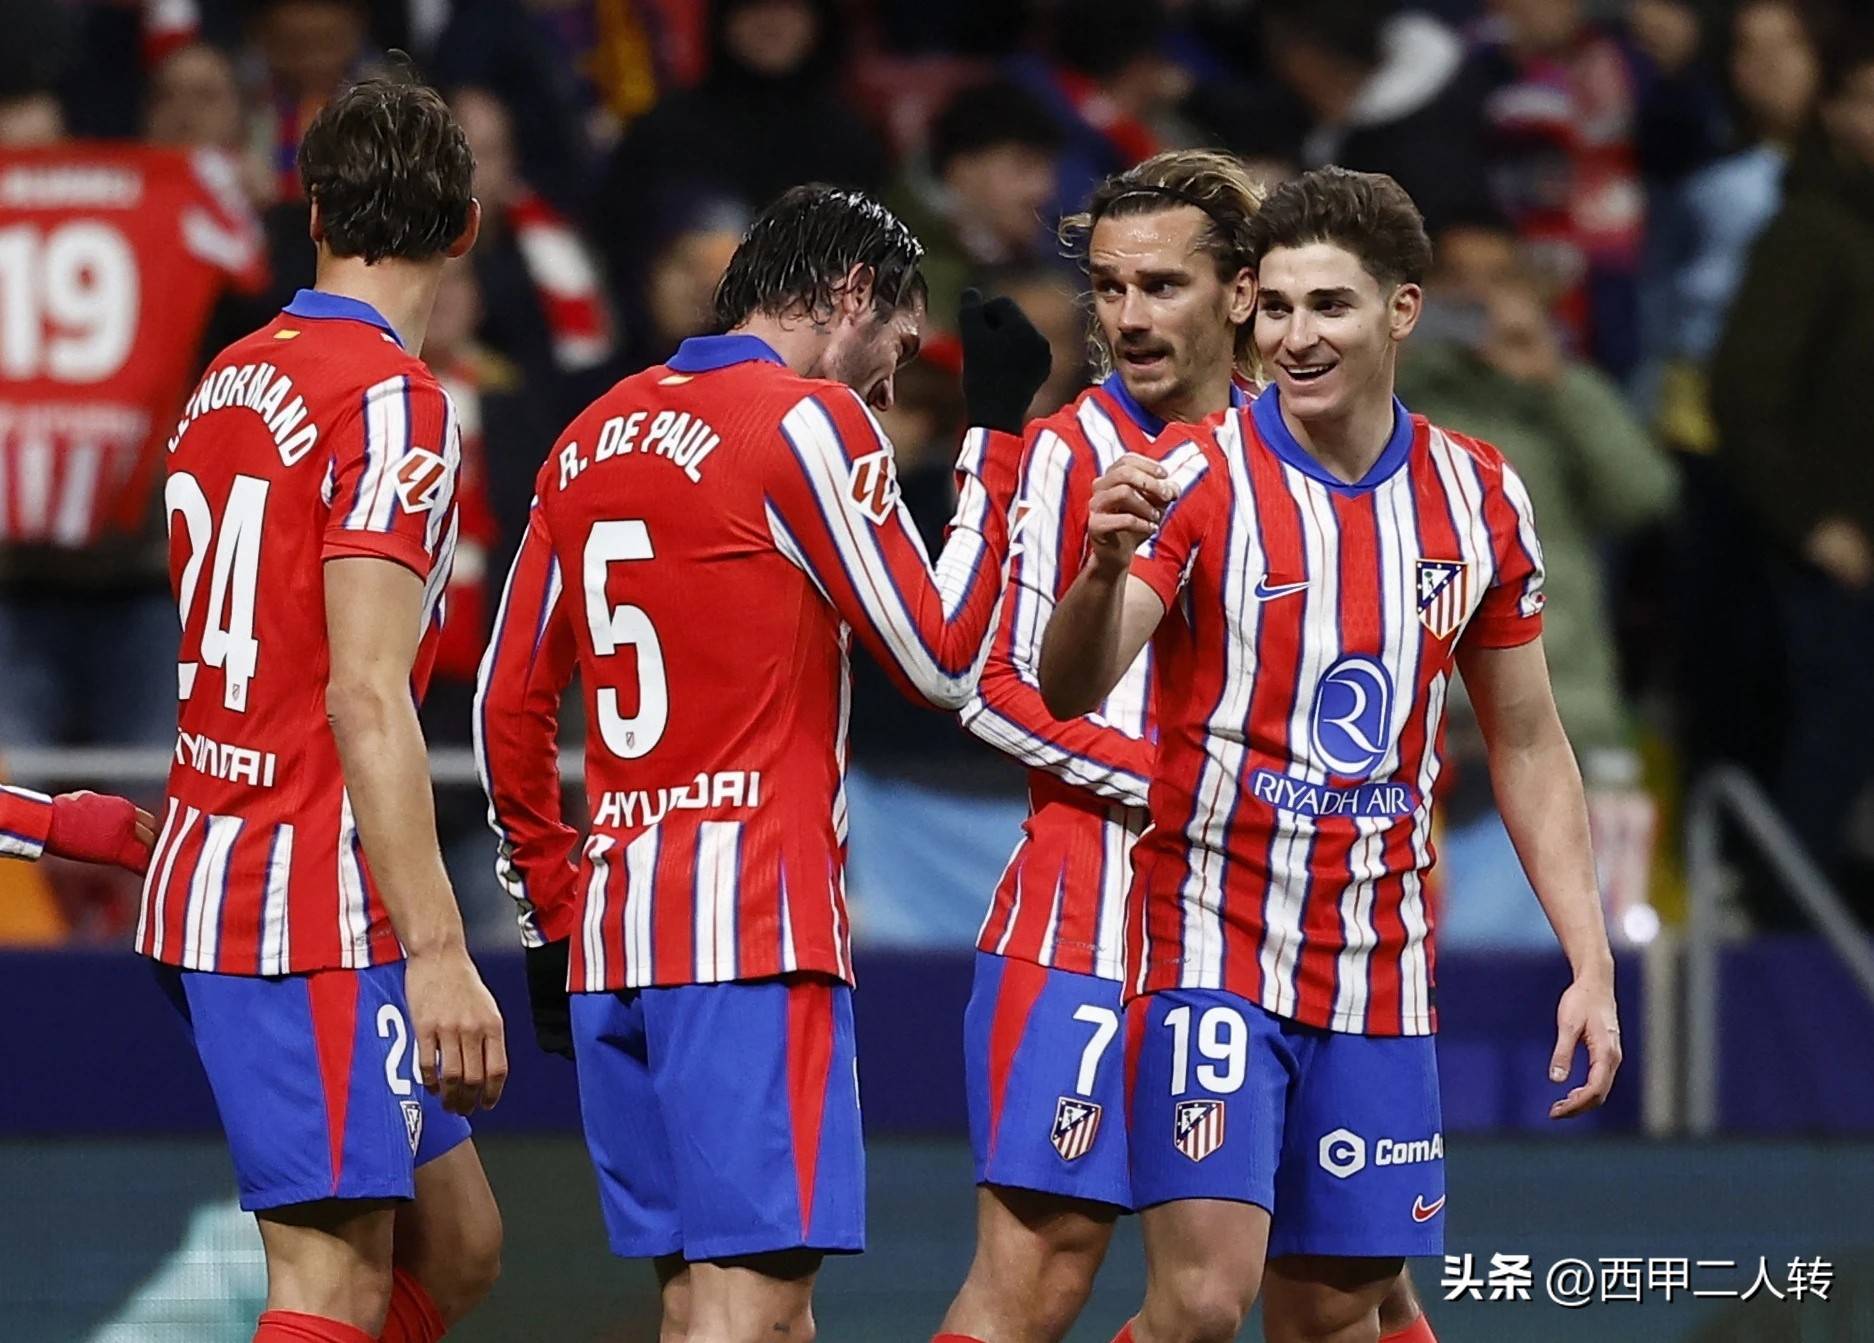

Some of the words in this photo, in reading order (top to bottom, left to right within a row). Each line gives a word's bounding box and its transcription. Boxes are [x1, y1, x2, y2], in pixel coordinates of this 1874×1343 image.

[0, 222, 141, 381] 19
[559, 441, 588, 491] R.
[595, 411, 647, 463] DE
[642, 411, 720, 483] PAUL
[164, 471, 270, 713] 24
[583, 519, 669, 759] 5
[1255, 773, 1358, 814] RIYADH
[1366, 788, 1409, 813] AIR
[377, 1004, 424, 1095] 2
[1073, 1004, 1118, 1096] 7
[1163, 1006, 1248, 1096] 19
[1376, 1133, 1443, 1166] ComA
